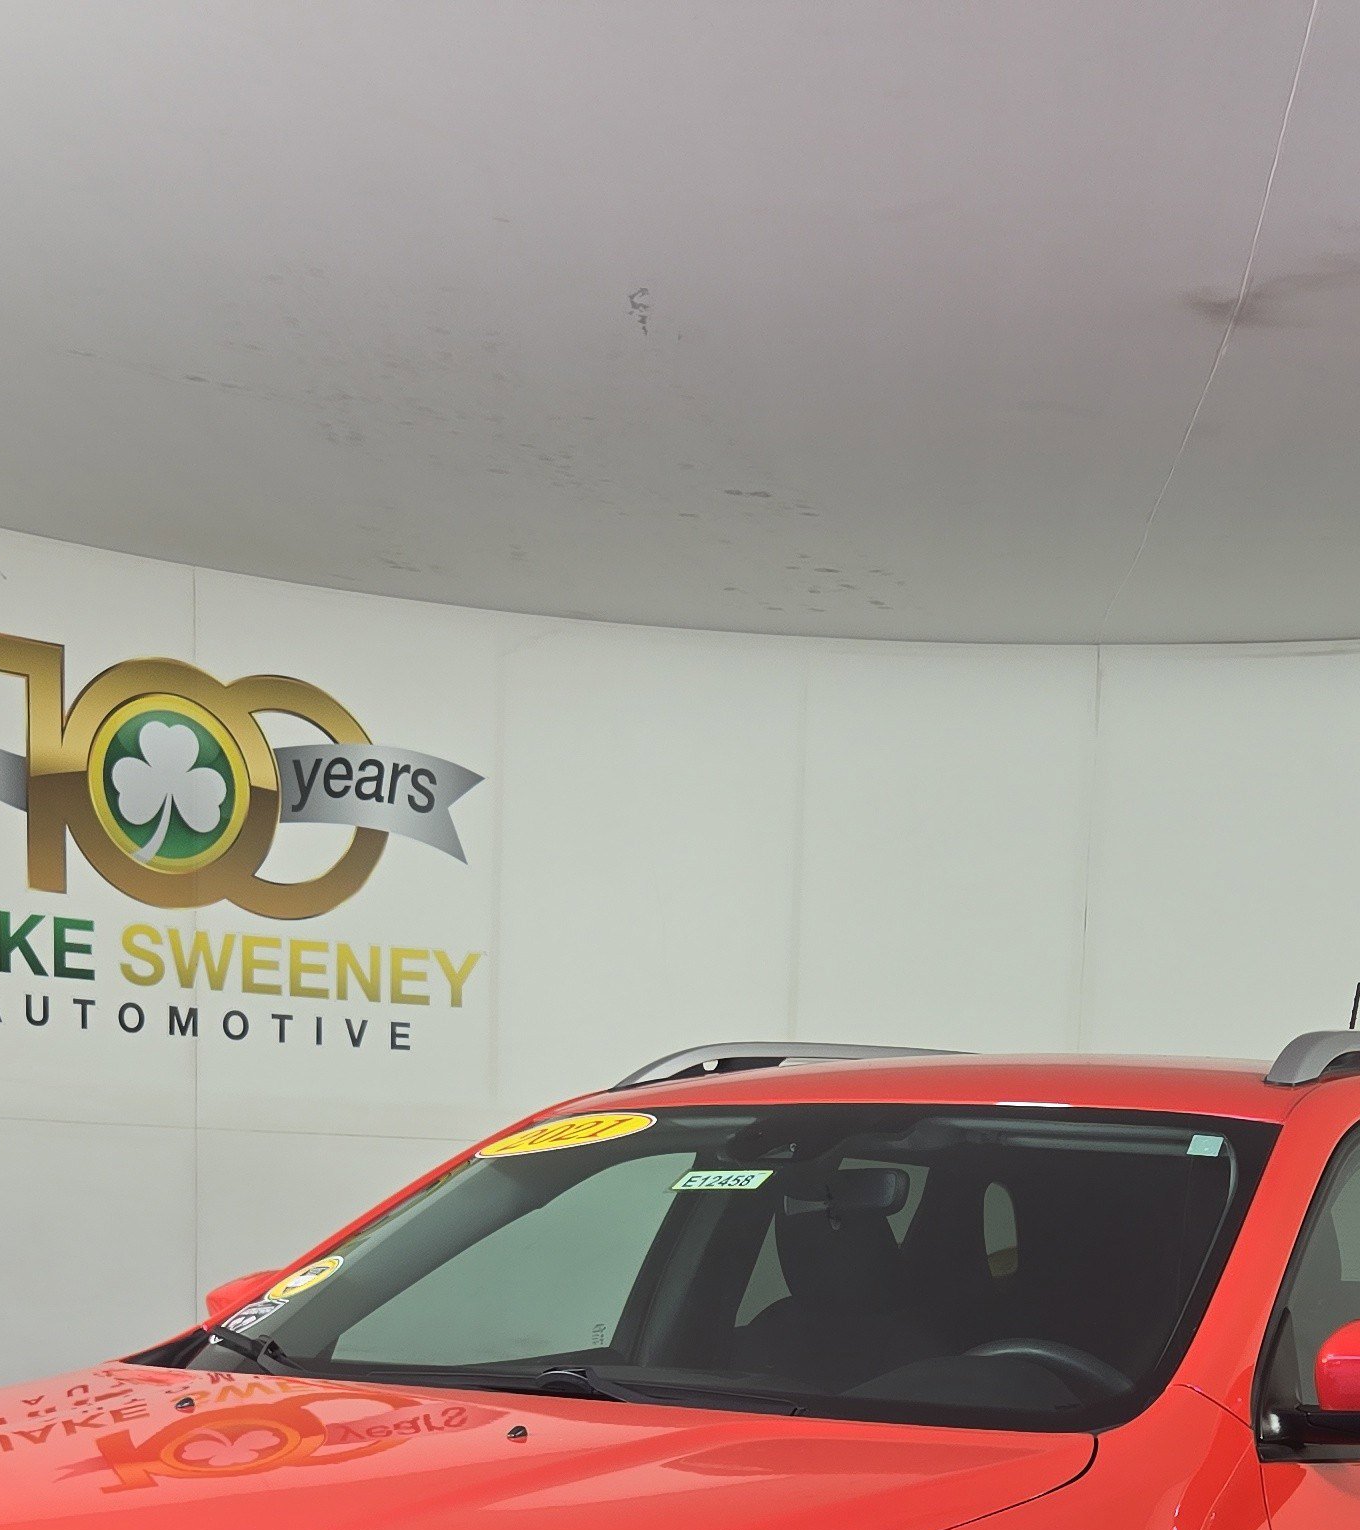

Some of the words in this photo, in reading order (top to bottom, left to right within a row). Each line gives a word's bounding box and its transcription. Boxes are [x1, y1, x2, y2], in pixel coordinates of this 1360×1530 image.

[291, 752, 437, 814] years
[119, 924, 481, 1008] SWEENEY
[497, 1117, 634, 1152] 2021
[683, 1174, 755, 1188] E12458
